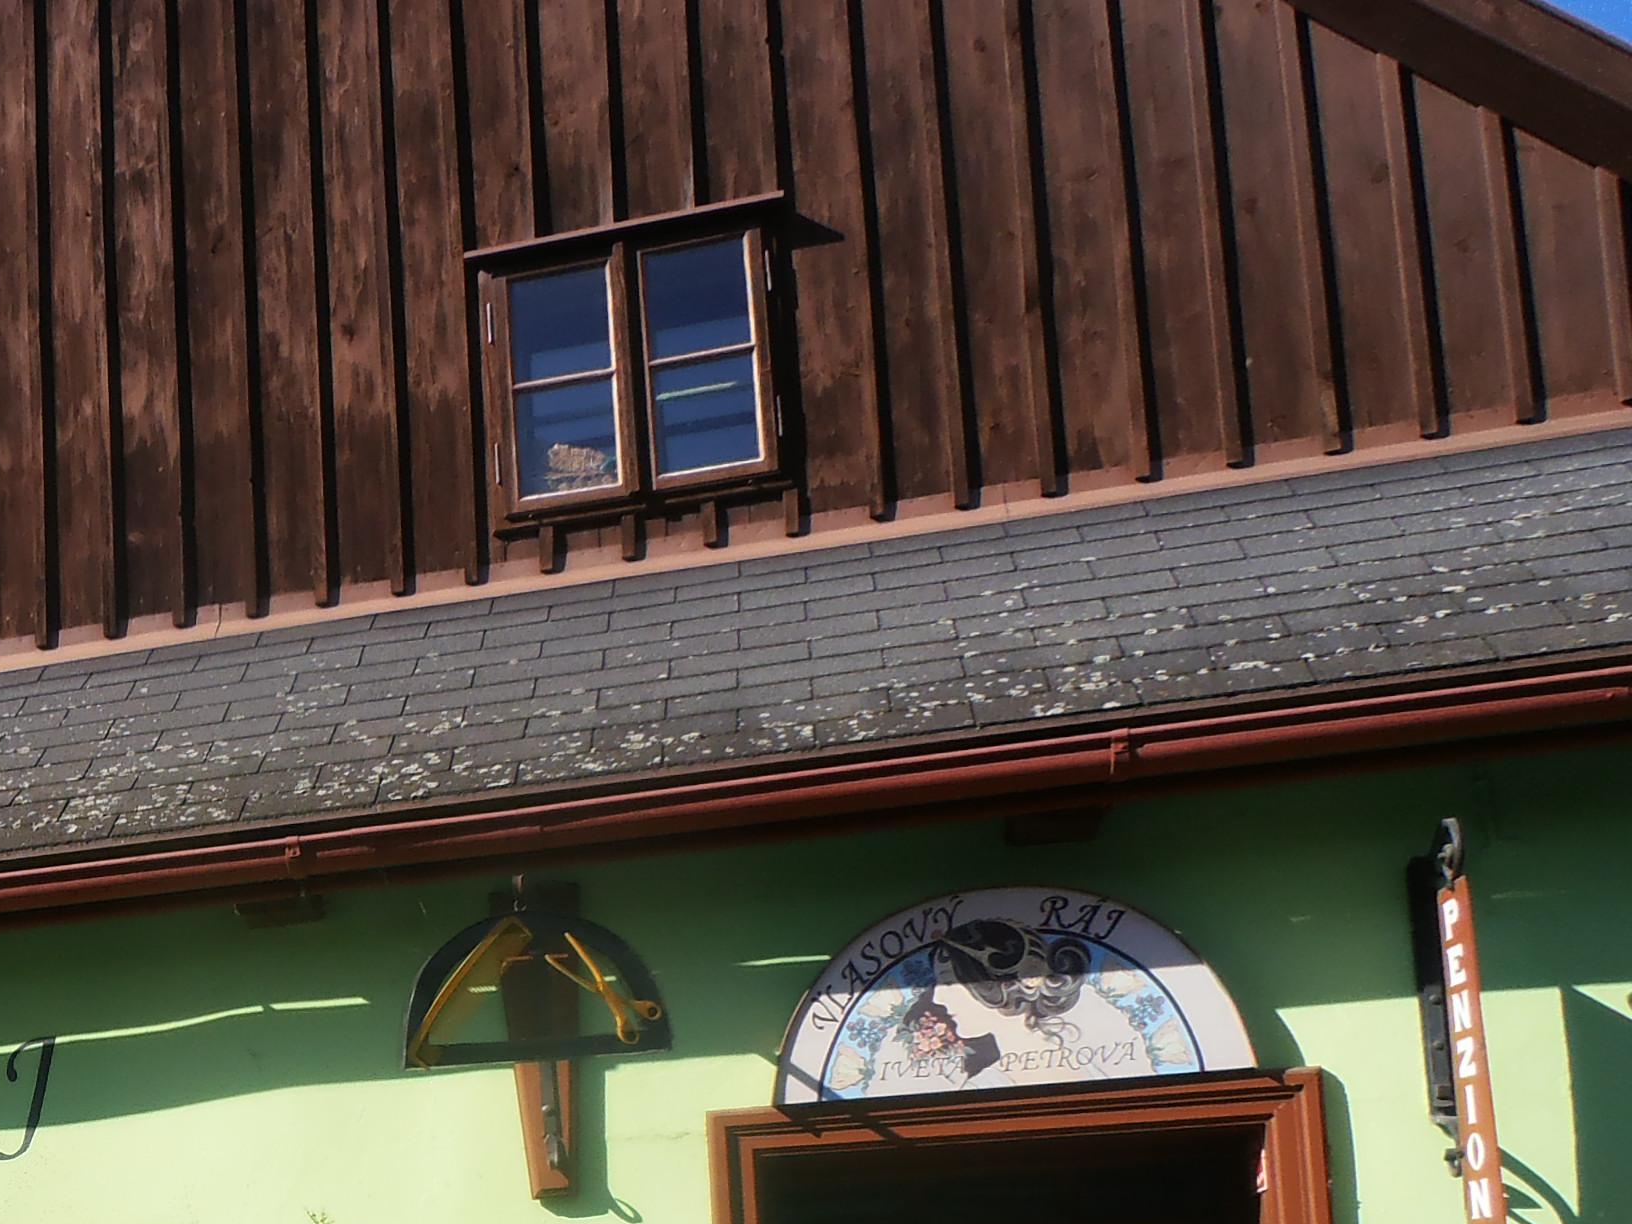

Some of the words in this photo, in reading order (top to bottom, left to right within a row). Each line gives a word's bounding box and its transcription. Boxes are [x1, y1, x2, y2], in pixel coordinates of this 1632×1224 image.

[811, 895, 964, 1030] VLASOVÝ
[1039, 895, 1126, 940] RÁJ
[879, 1054, 968, 1082] IVETA
[998, 1036, 1138, 1073] PETROVÁ
[1442, 898, 1493, 1220] PENZION
